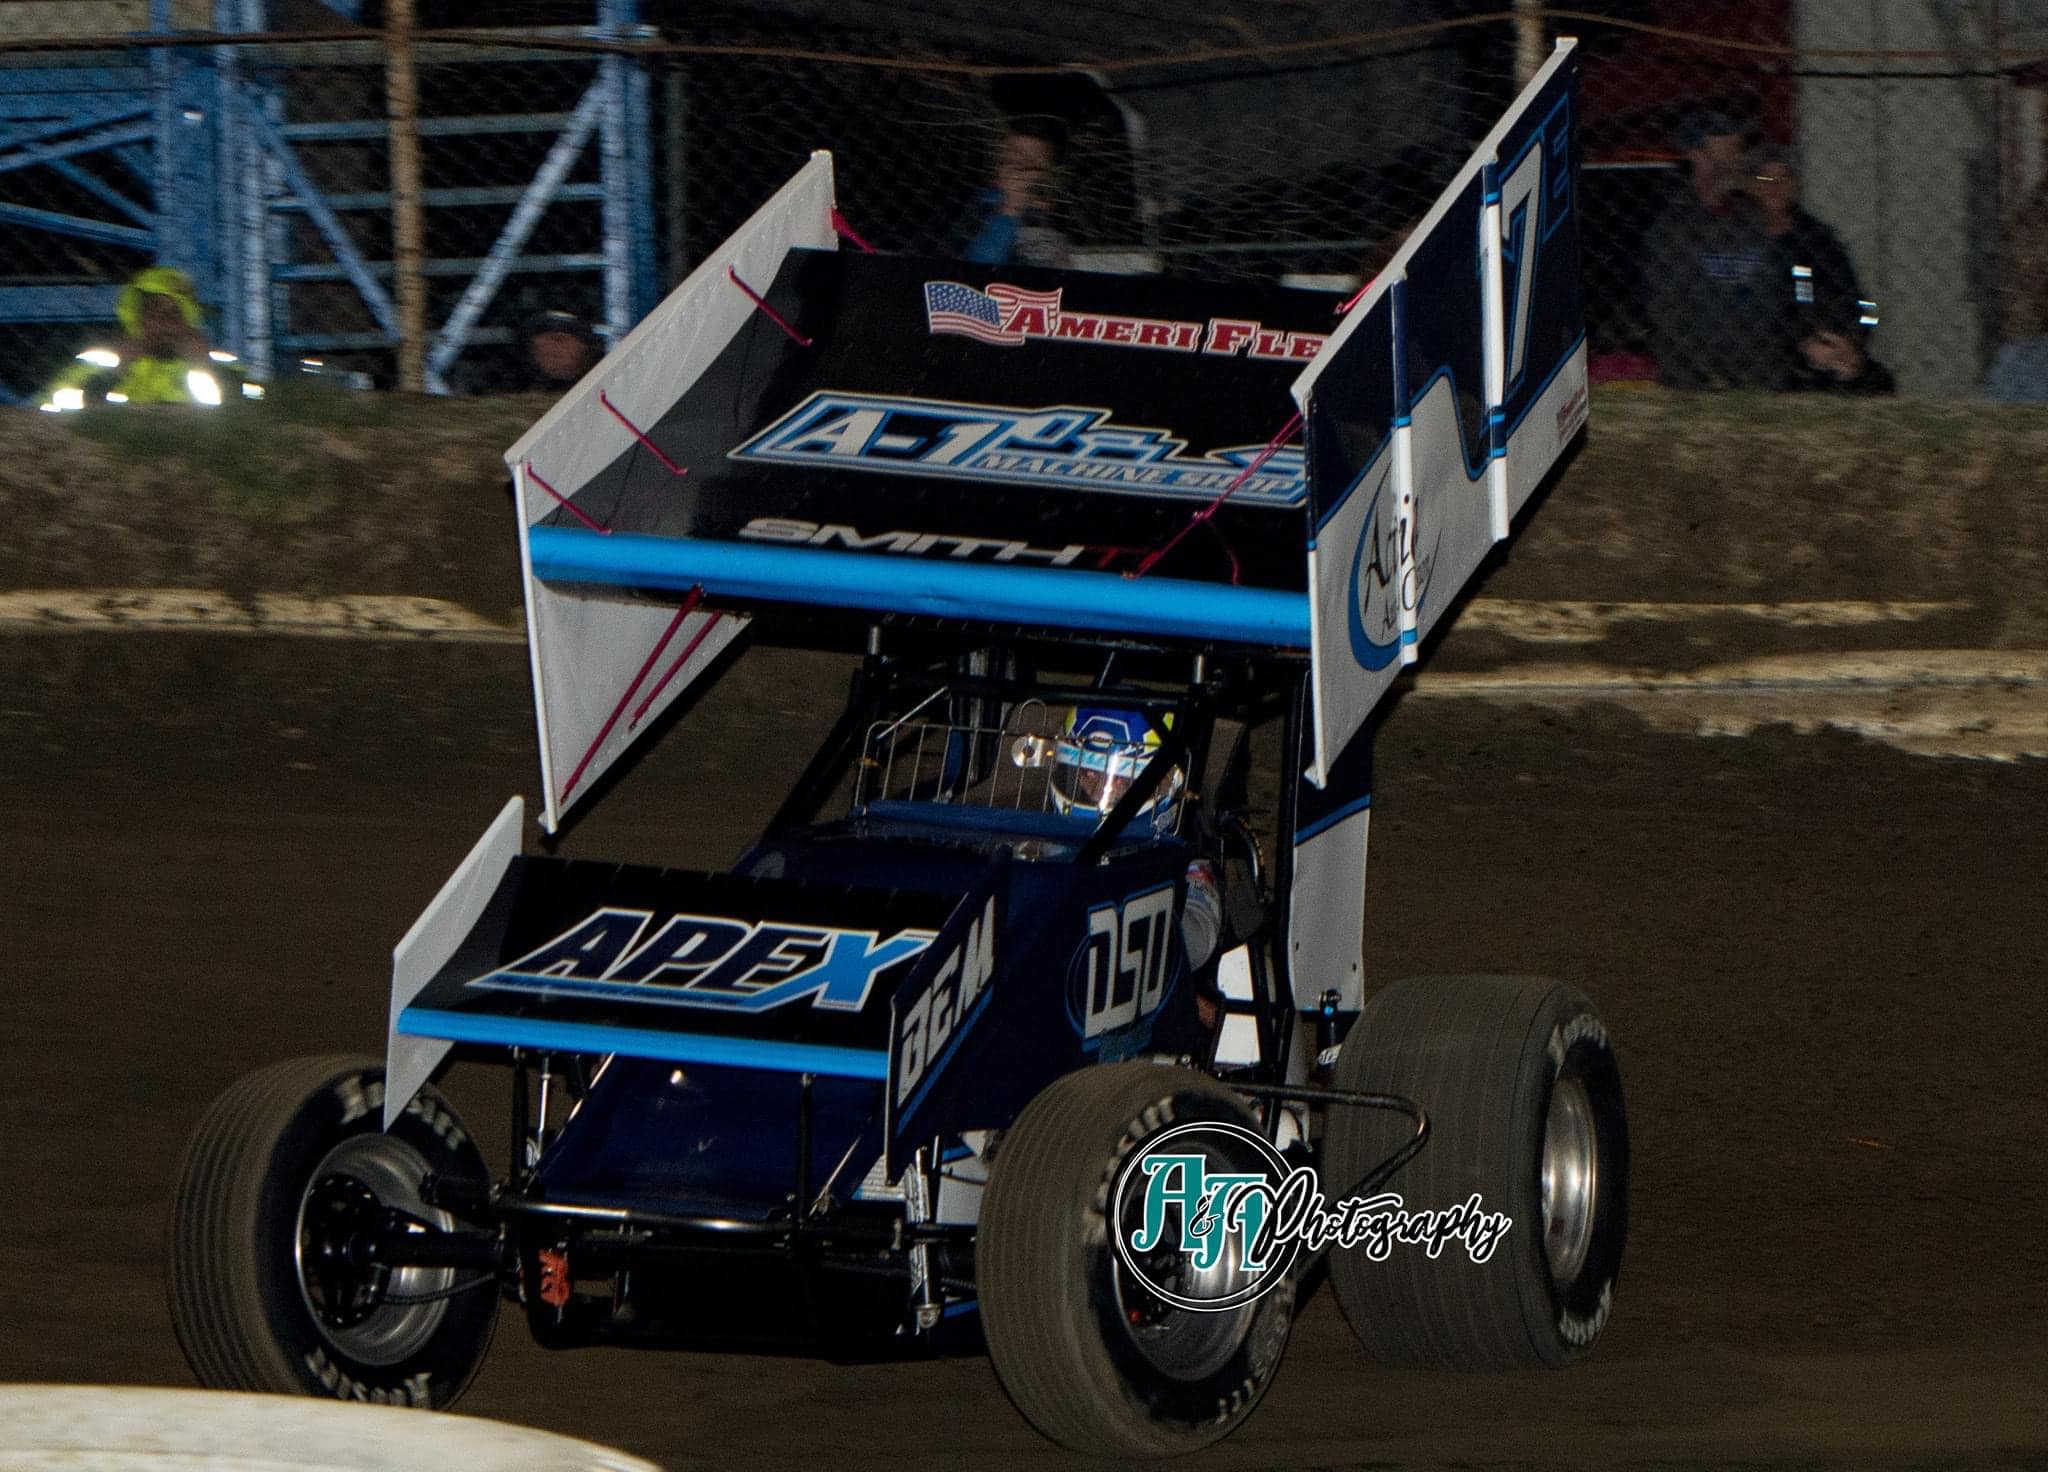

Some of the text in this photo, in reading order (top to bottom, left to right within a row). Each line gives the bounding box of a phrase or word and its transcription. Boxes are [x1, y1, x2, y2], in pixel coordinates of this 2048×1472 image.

[1005, 305, 1201, 351] AMERI
[782, 409, 998, 468] A-1
[974, 453, 1296, 494] MACHINE SHOP
[475, 907, 940, 1013] APEX
